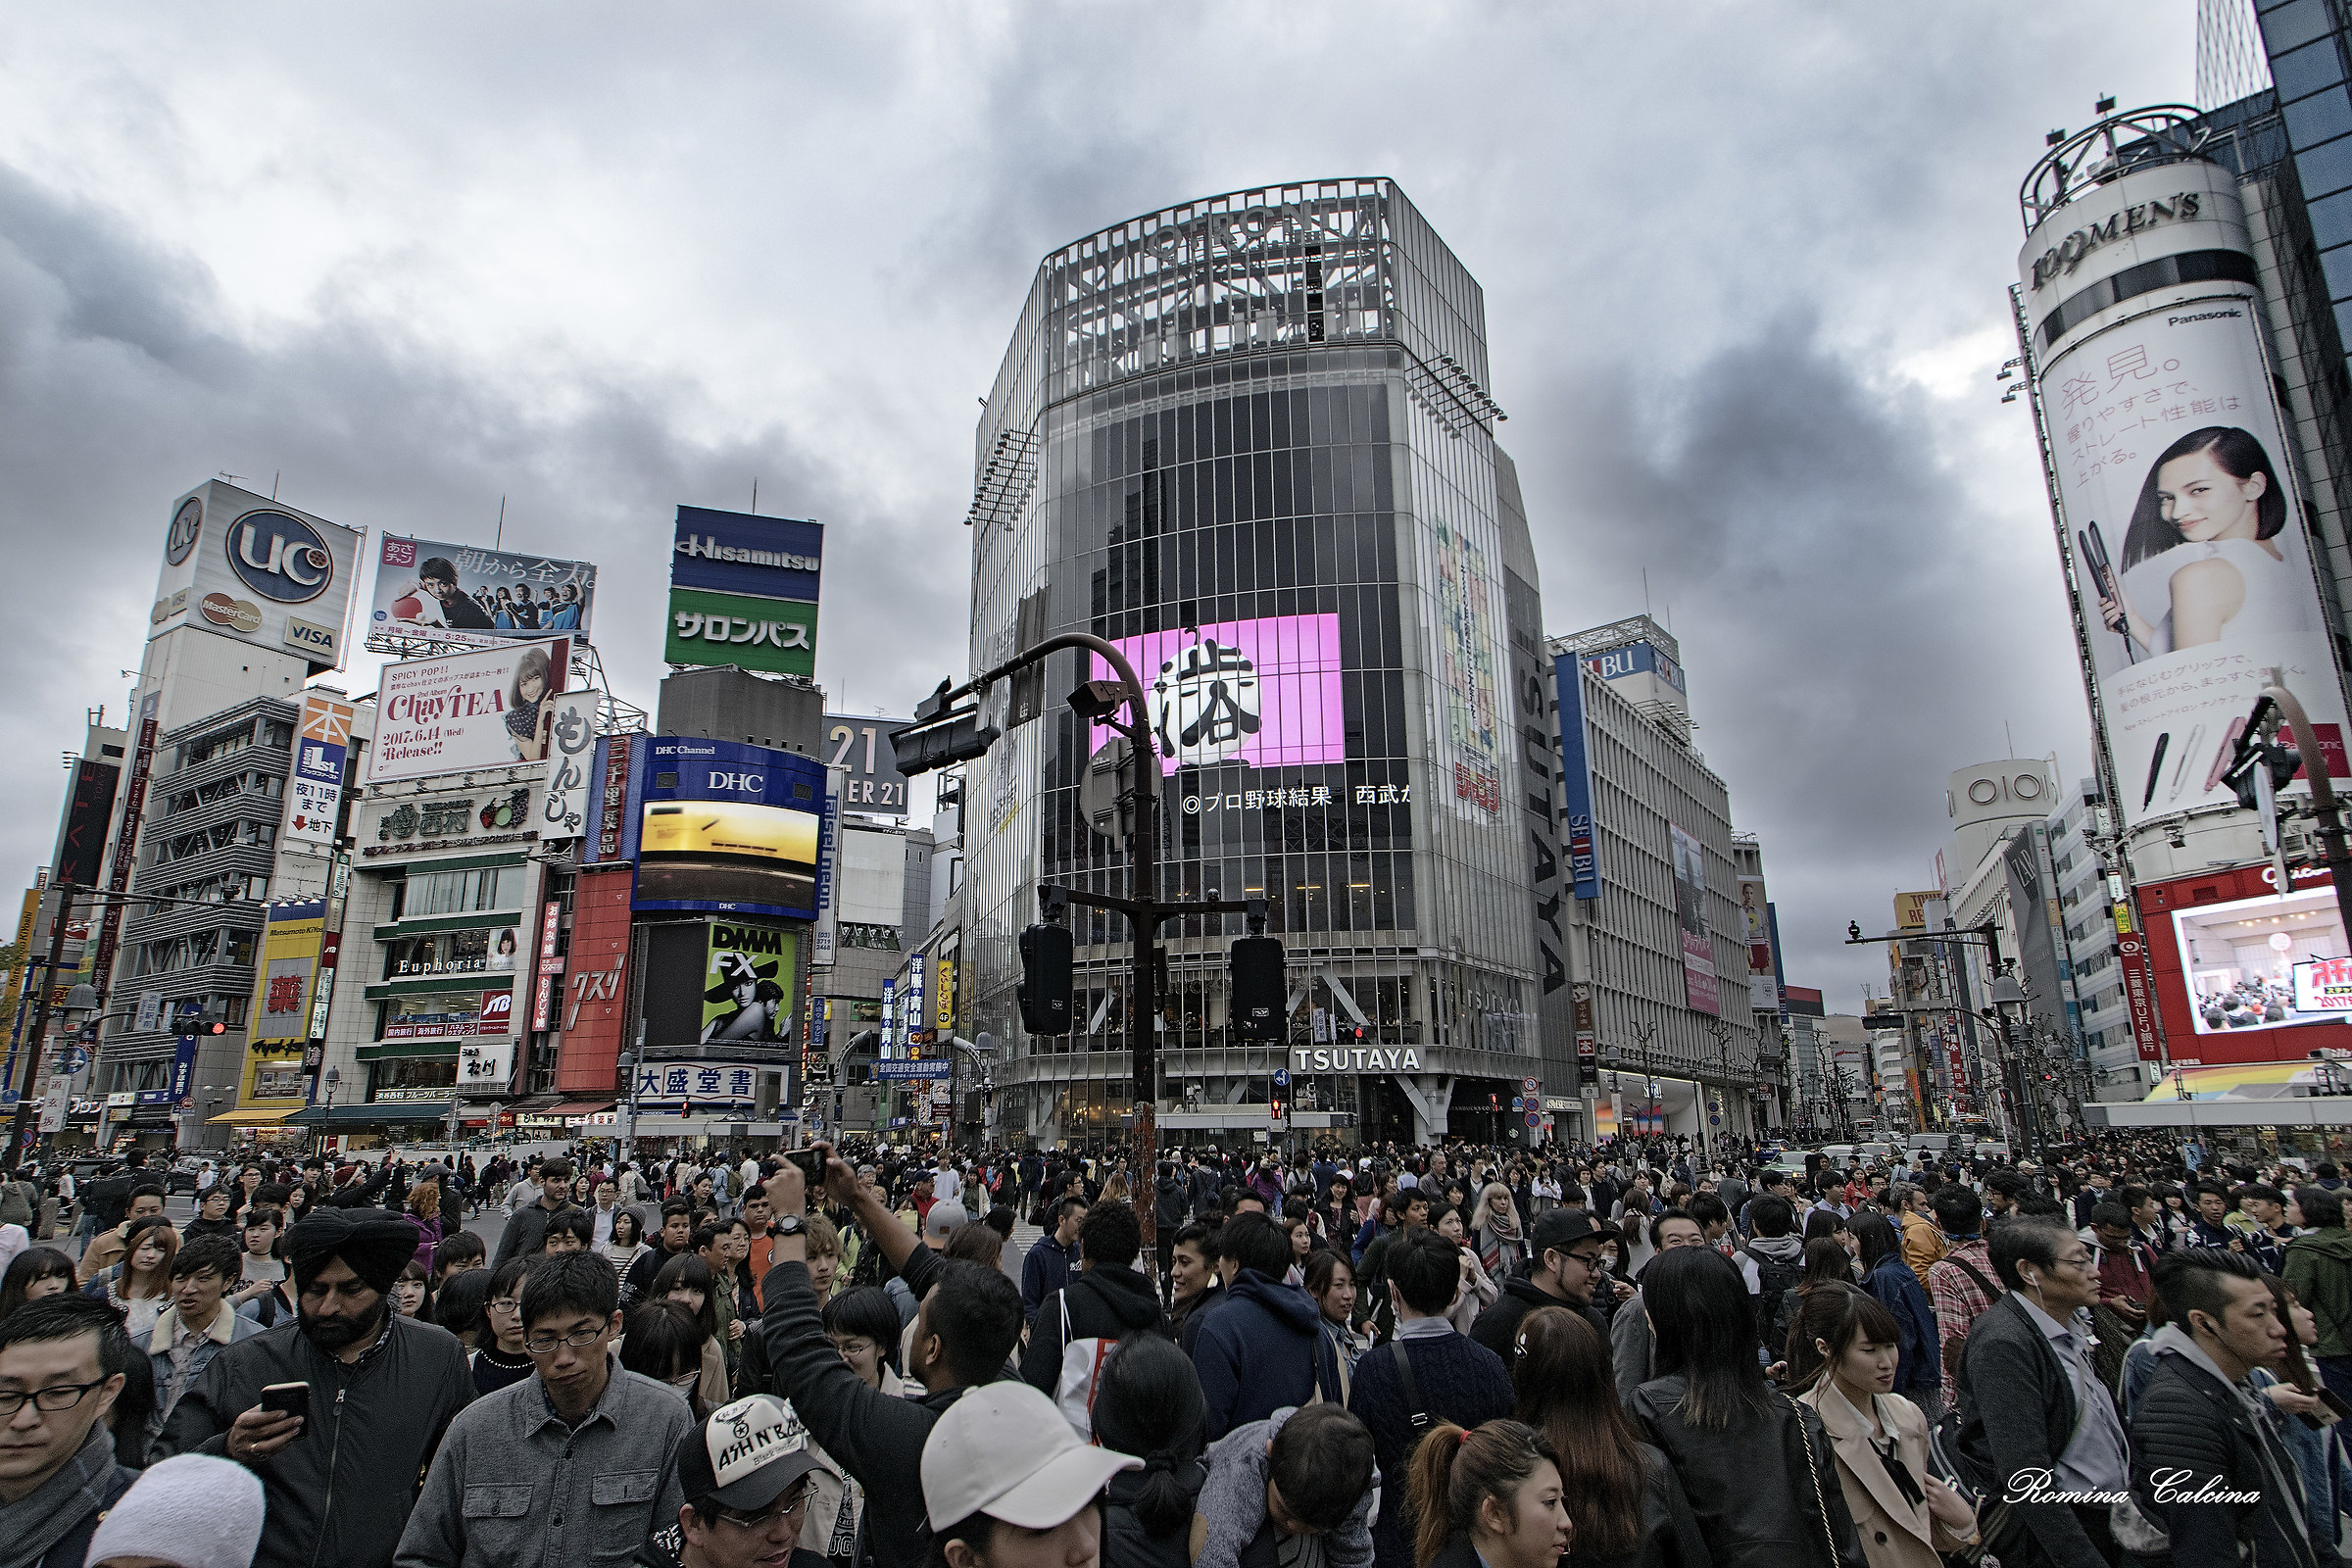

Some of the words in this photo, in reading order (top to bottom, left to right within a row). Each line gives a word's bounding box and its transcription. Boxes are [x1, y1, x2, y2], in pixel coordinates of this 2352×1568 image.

[2169, 308, 2242, 326] Panasonic
[2062, 344, 2180, 420] 発見。
[2077, 448, 2136, 488] 上がる。
[386, 554, 413, 564] チャン
[387, 542, 414, 555] あさ
[674, 534, 820, 571] Hisamitsu
[202, 600, 262, 625] MasterCard
[293, 625, 333, 649] VISA
[674, 610, 809, 651] サロンパス
[392, 669, 418, 682] SPICY
[420, 665, 449, 677] POP!!
[383, 726, 440, 747] 2017.6.14
[444, 727, 465, 738] (Wed)
[381, 741, 443, 760] Release!!
[656, 746, 677, 755] DHC
[677, 745, 715, 755] Channel
[829, 726, 876, 774] 21
[545, 706, 592, 834] もんじゃ
[708, 771, 763, 792] DHC
[296, 782, 337, 803] 夜11時
[880, 782, 904, 807] 21
[302, 798, 328, 813] まで
[308, 818, 333, 834] 地下
[1570, 813, 1594, 883] SEIBU
[270, 928, 306, 937] Matsumoto
[712, 924, 783, 956] DMM
[398, 957, 481, 975] Euphoria
[710, 952, 759, 978] FX
[268, 975, 303, 1013] 薬
[565, 953, 626, 1031] クスリ
[908, 957, 924, 1026] 洋服の青山
[482, 994, 511, 1016] JTB
[388, 1028, 413, 1037] 国内旅行
[417, 1026, 443, 1035] 海外旅行
[880, 987, 894, 1059] 洋服の青山
[1580, 1040, 1592, 1053] 本
[1295, 1049, 1420, 1071] TSUTAYA
[43, 1080, 62, 1126] 道玄坂
